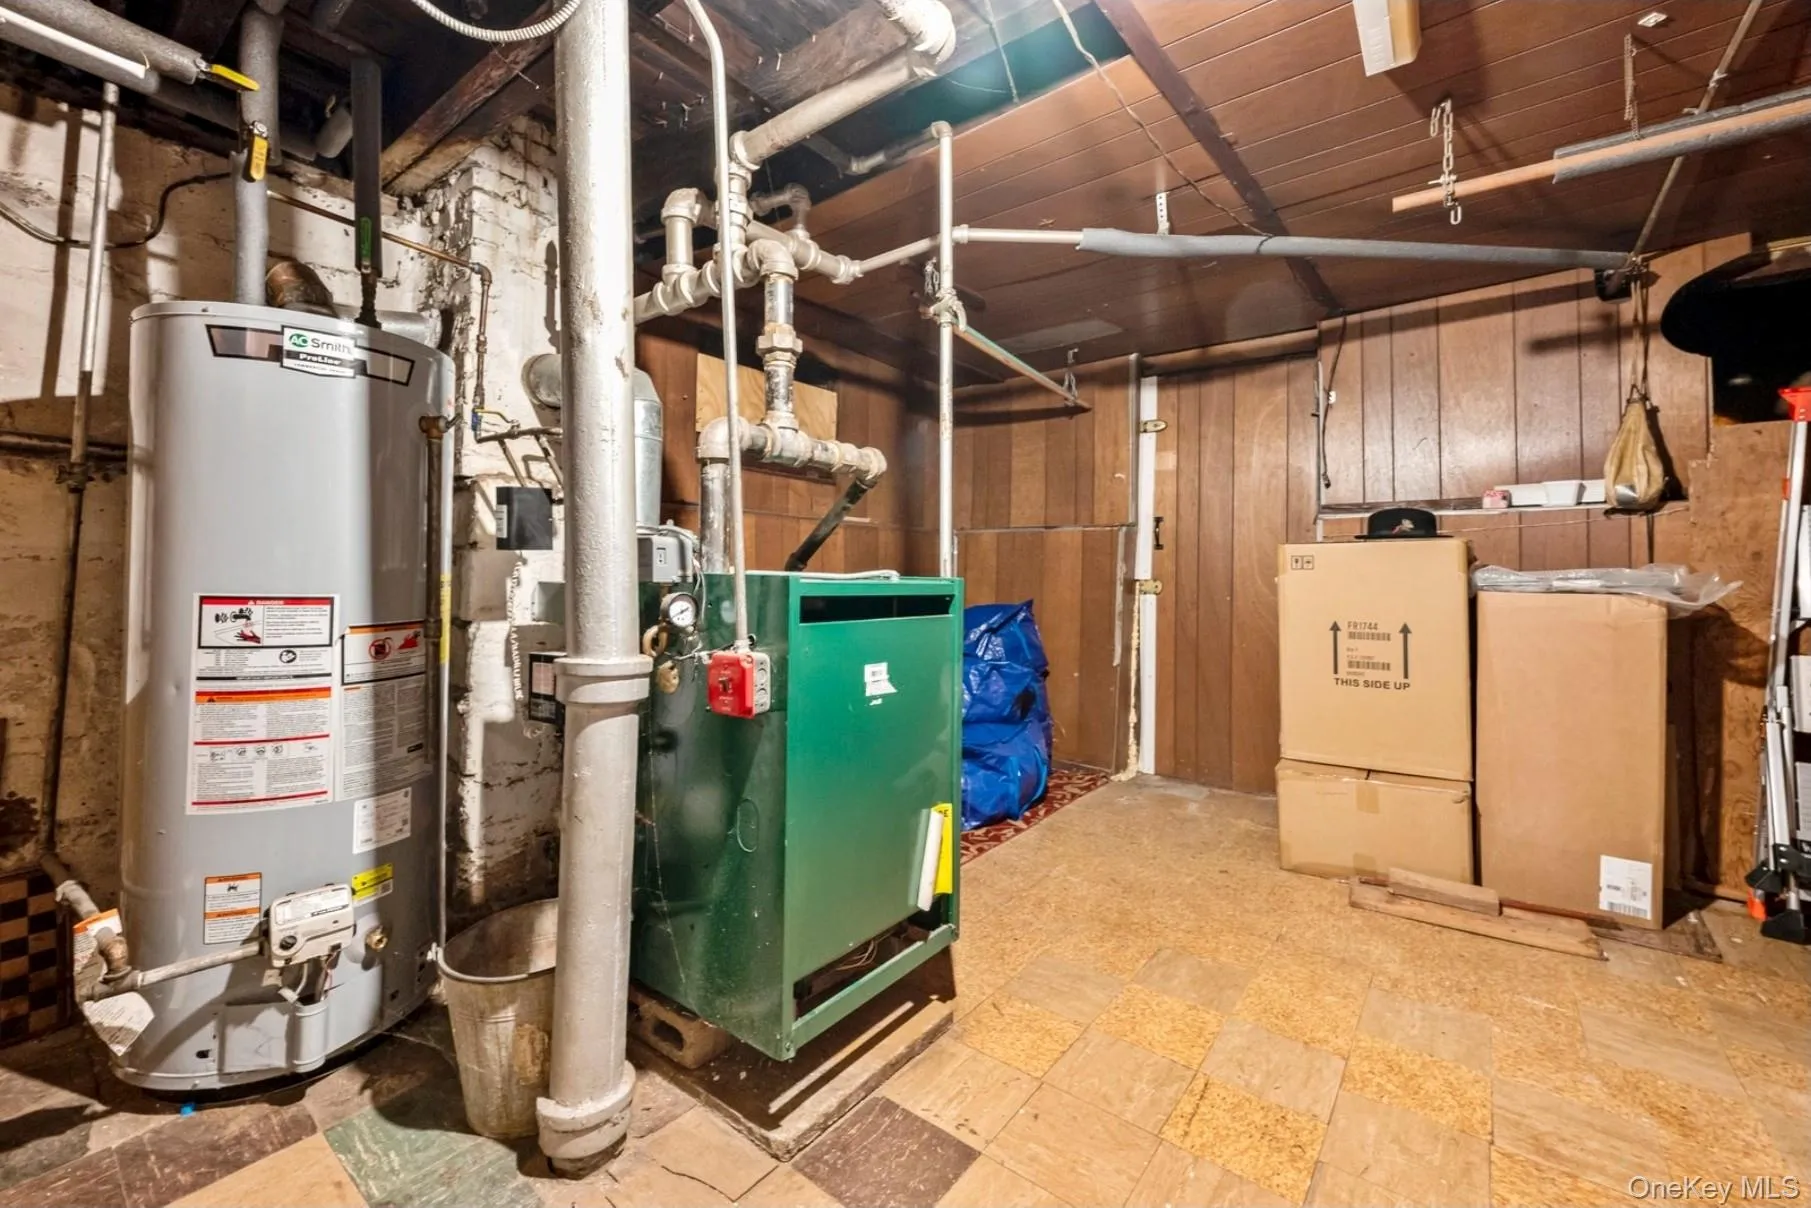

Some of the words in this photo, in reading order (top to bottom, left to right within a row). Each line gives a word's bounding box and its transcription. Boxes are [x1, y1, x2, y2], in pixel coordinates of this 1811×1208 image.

[310, 338, 351, 354] Smith
[1347, 621, 1378, 631] FR1744
[1334, 677, 1360, 688] THIS
[1363, 679, 1391, 690] SIDE
[1393, 681, 1411, 691] UP
